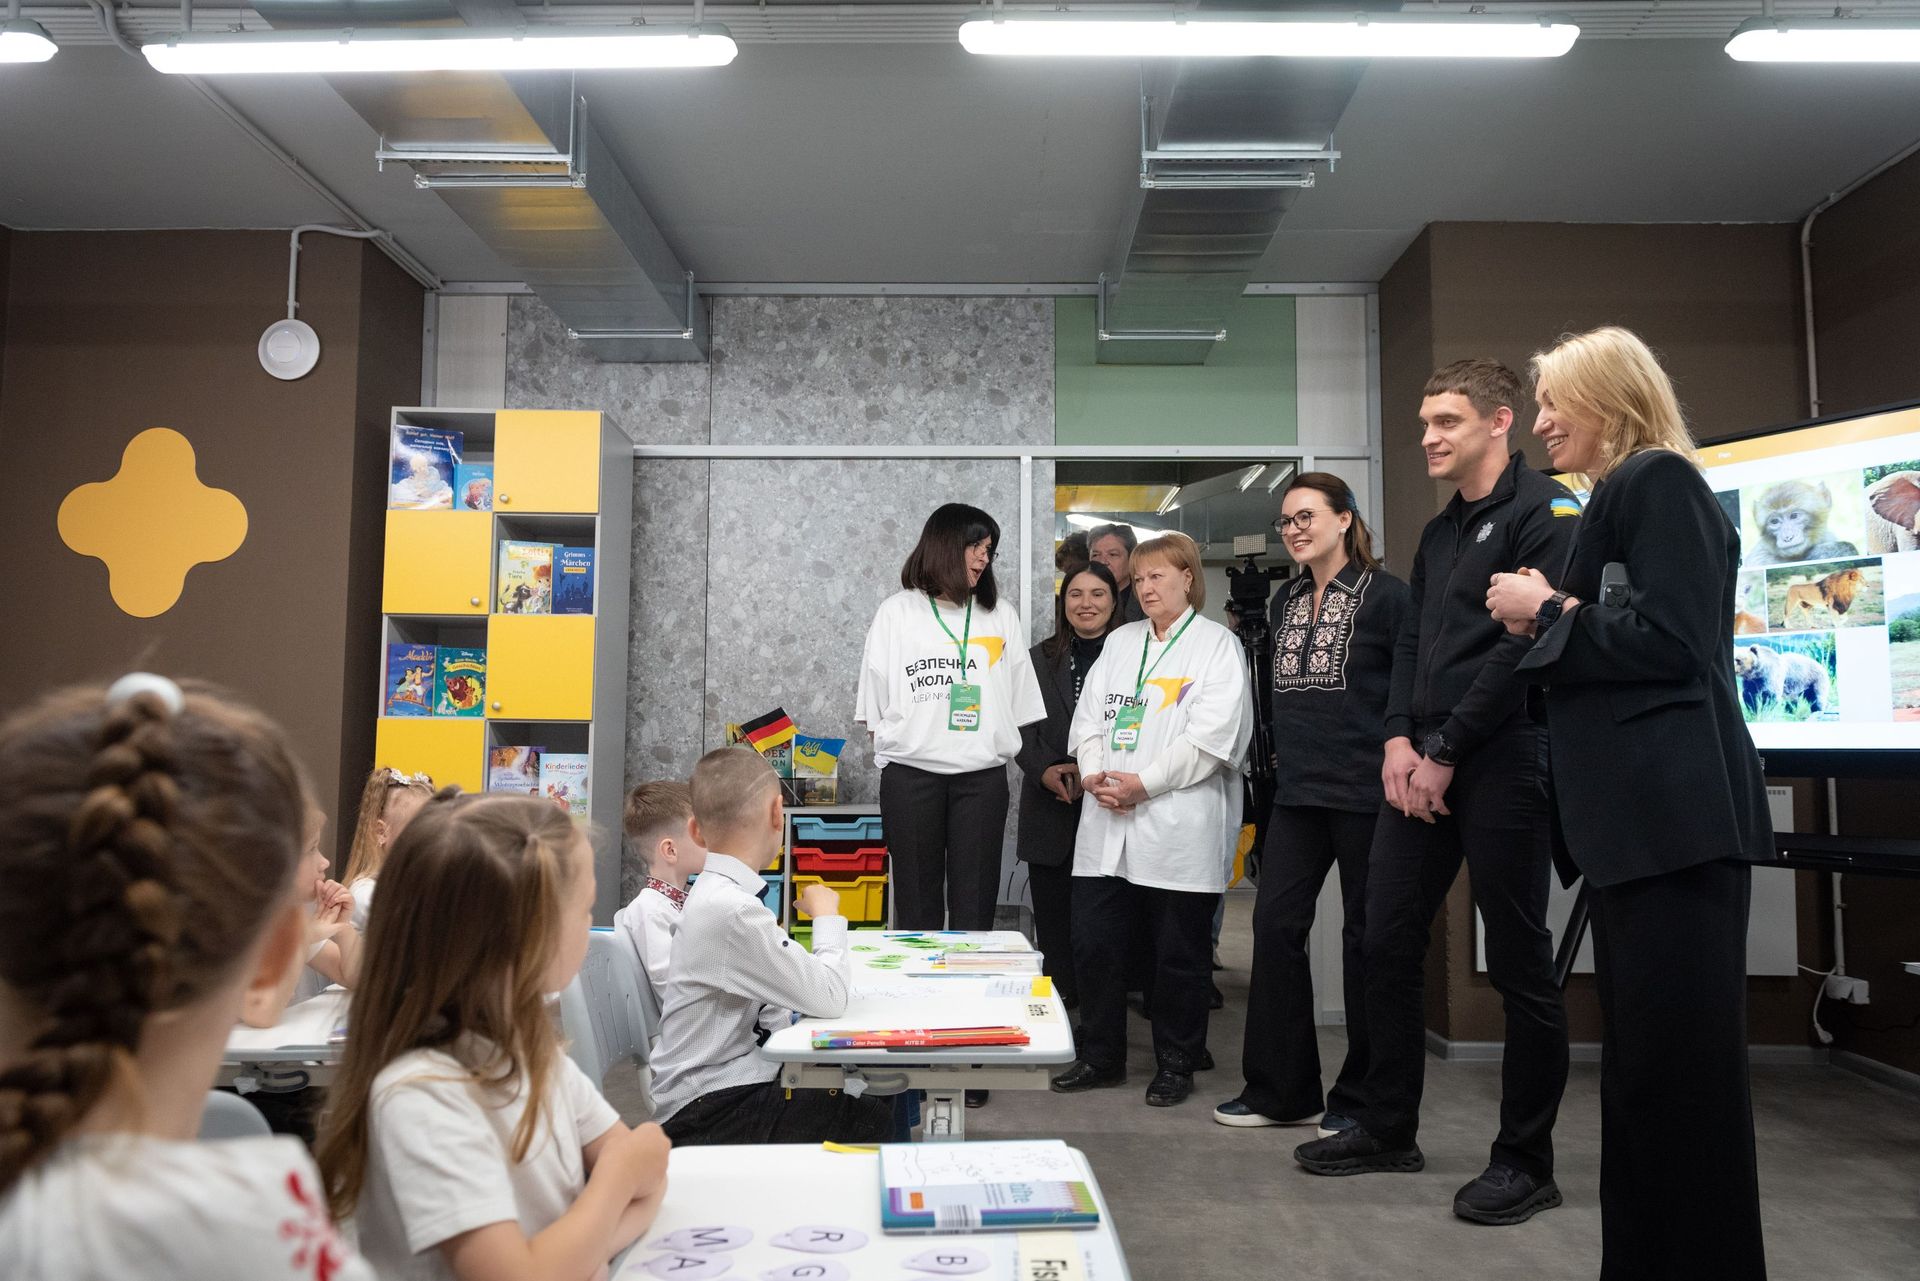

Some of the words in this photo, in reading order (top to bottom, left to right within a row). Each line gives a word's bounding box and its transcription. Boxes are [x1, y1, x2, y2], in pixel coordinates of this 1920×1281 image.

[564, 551, 586, 559] Grimms
[560, 558, 591, 567] Märchen
[689, 1227, 728, 1248] M
[809, 1230, 844, 1242] R
[667, 1256, 707, 1271] A
[936, 1255, 968, 1266] B
[792, 1265, 826, 1278] G
[1030, 1258, 1068, 1281] Fis
